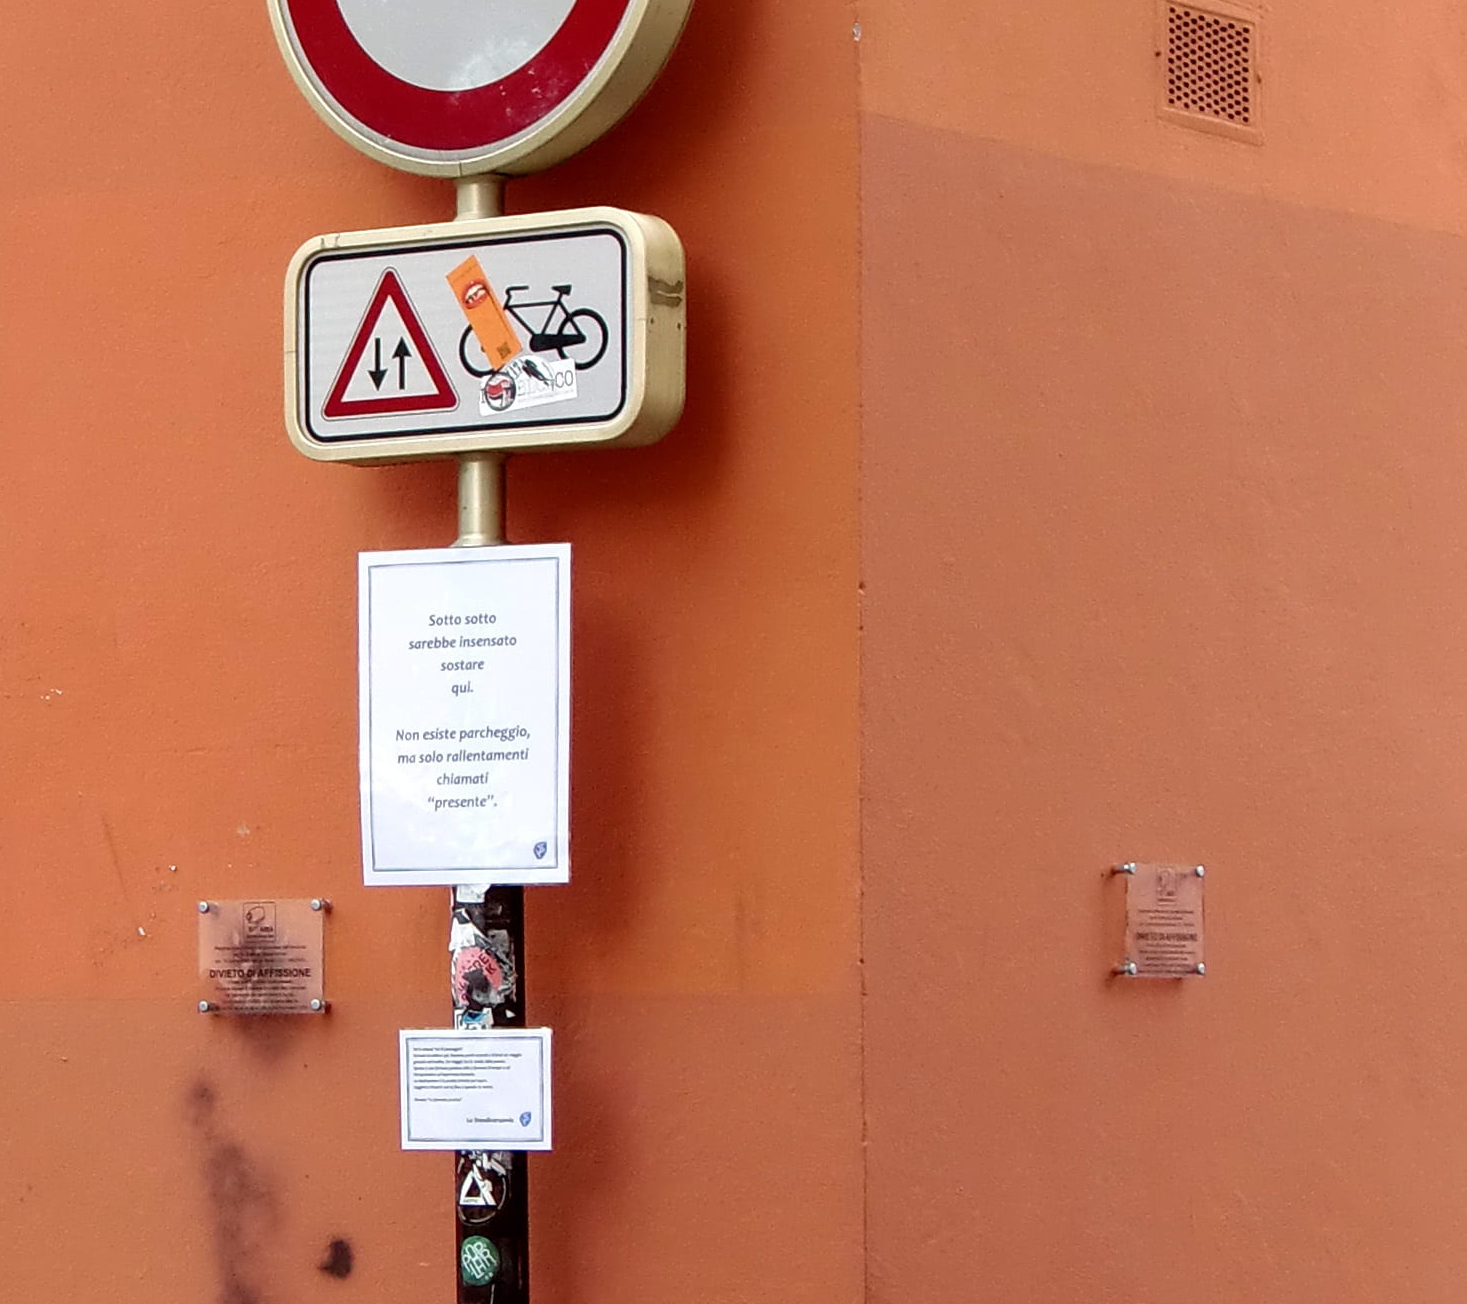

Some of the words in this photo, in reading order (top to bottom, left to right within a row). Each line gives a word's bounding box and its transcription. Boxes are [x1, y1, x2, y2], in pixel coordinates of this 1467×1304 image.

[429, 615, 461, 626] Sotto
[465, 614, 496, 624] sotto
[409, 637, 456, 649] sarebbe
[460, 636, 516, 647] insensato
[441, 661, 484, 671] sostare
[452, 681, 473, 696] qui.
[395, 729, 420, 741] Non
[423, 728, 456, 740] esiste
[459, 725, 530, 742] parcheggio,
[397, 753, 416, 764] ma
[419, 751, 443, 763] solo
[447, 748, 529, 762] rallentamenti
[437, 772, 488, 785] chiamati
[209, 969, 245, 979] DIVIETO
[258, 968, 311, 978] AFFISSIONE
